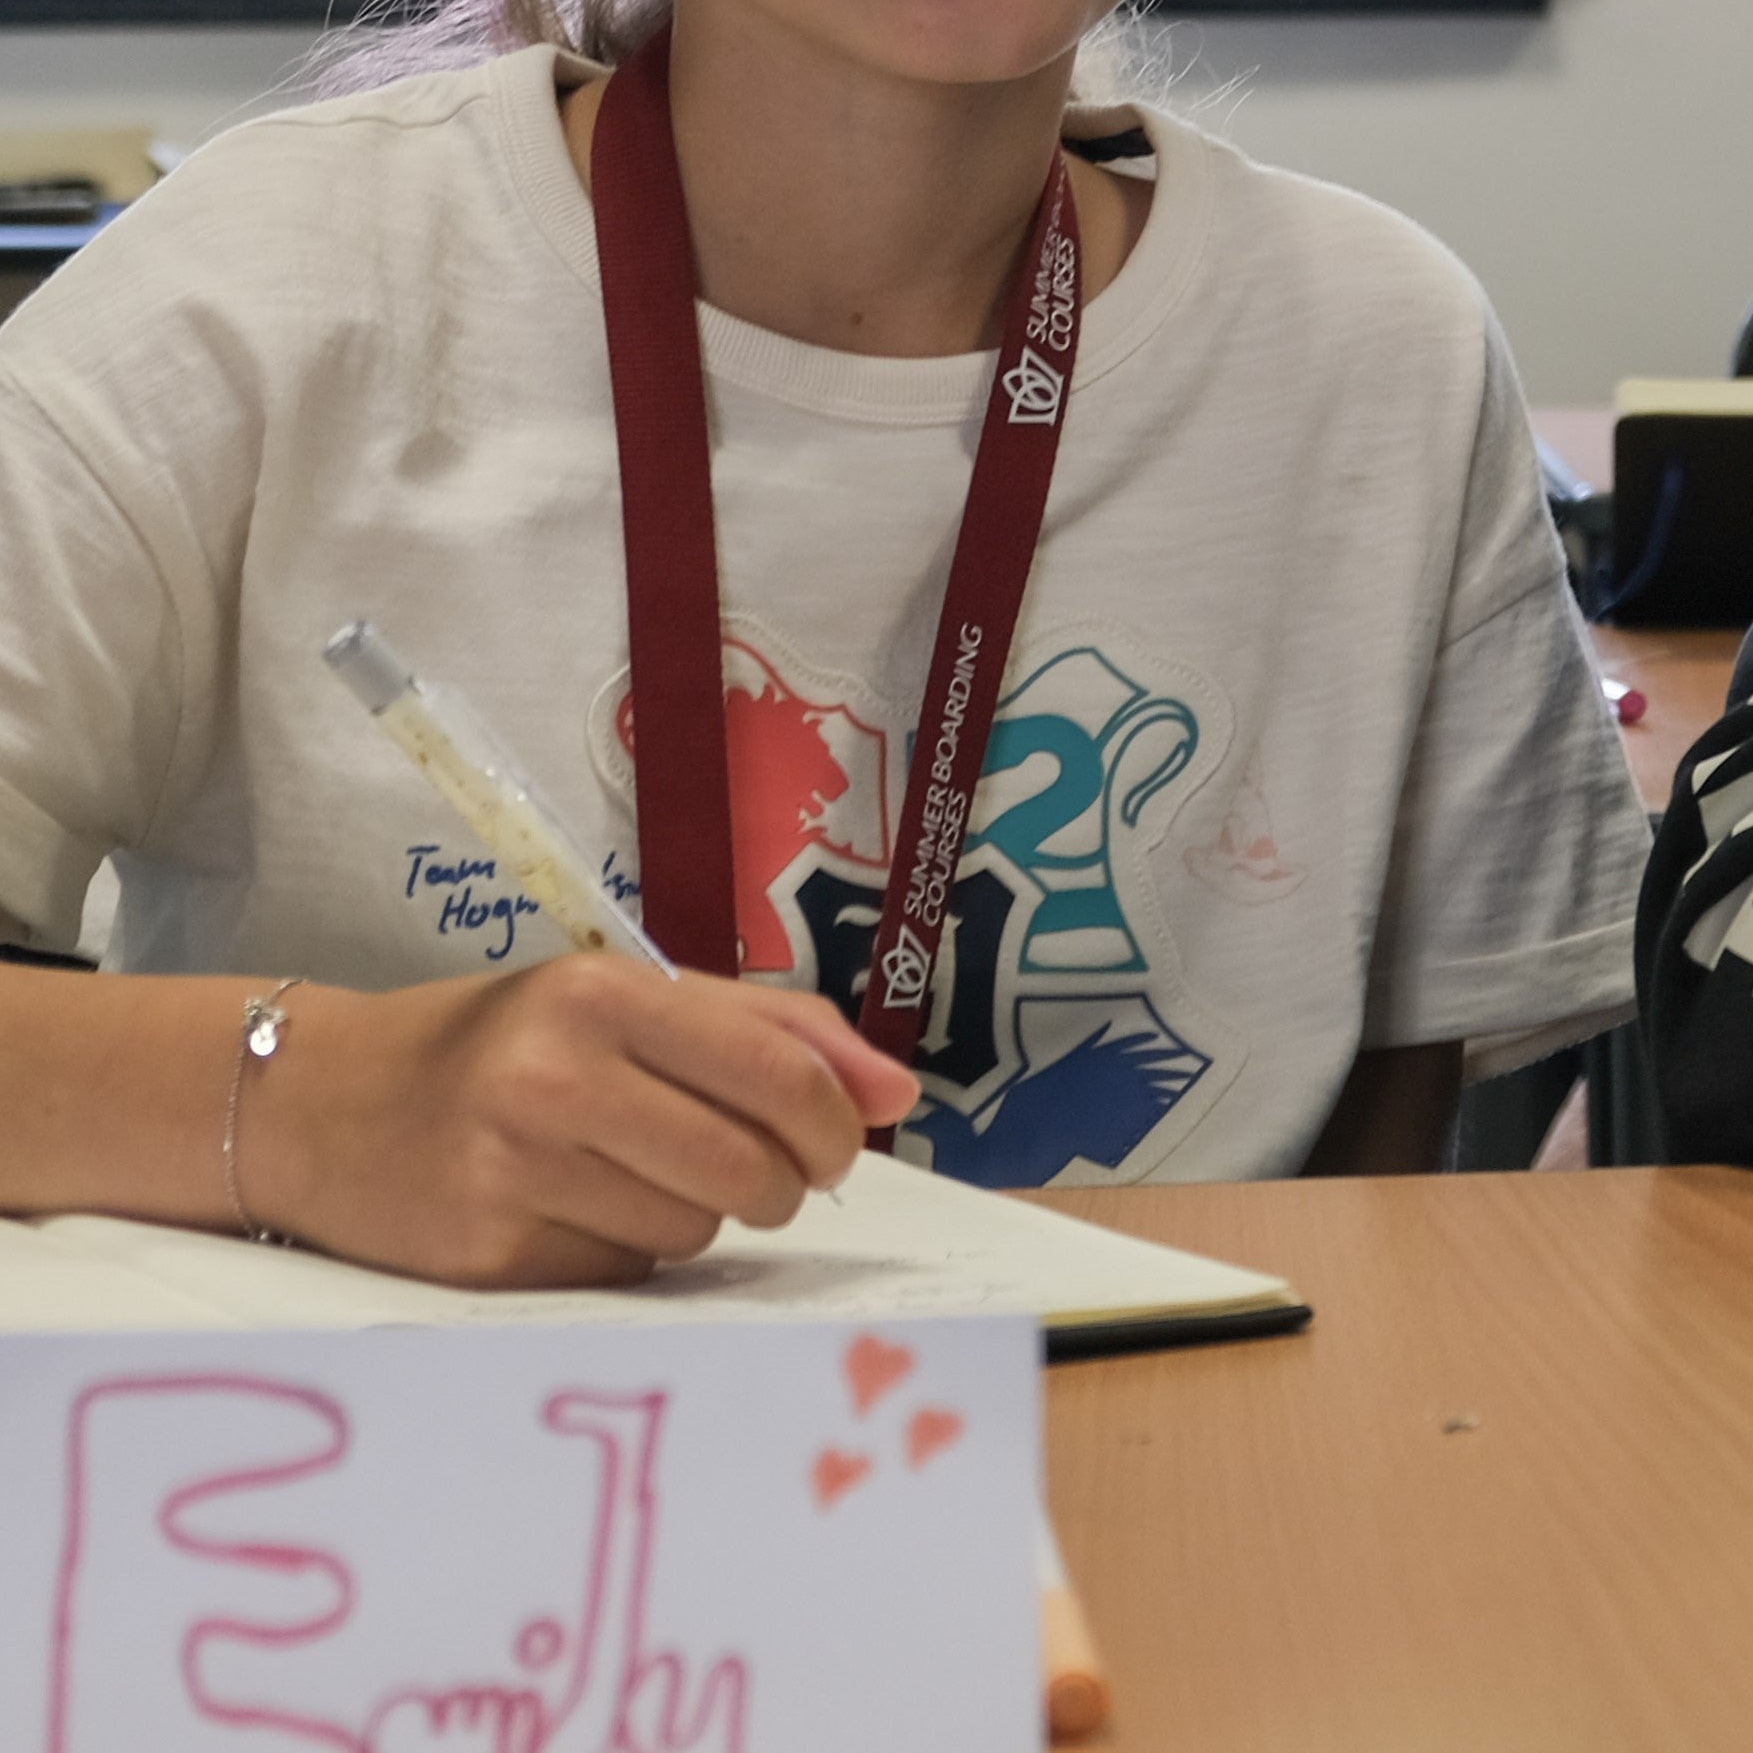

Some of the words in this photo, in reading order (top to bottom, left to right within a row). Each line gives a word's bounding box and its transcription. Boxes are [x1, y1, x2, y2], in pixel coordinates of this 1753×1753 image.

[1026, 226, 1060, 344] SUMMER
[1048, 237, 1075, 352] COURSES
[904, 787, 947, 919] SUMMER
[931, 622, 983, 783] BOARDING
[406, 845, 496, 898] Team
[923, 788, 967, 928] COURSES
